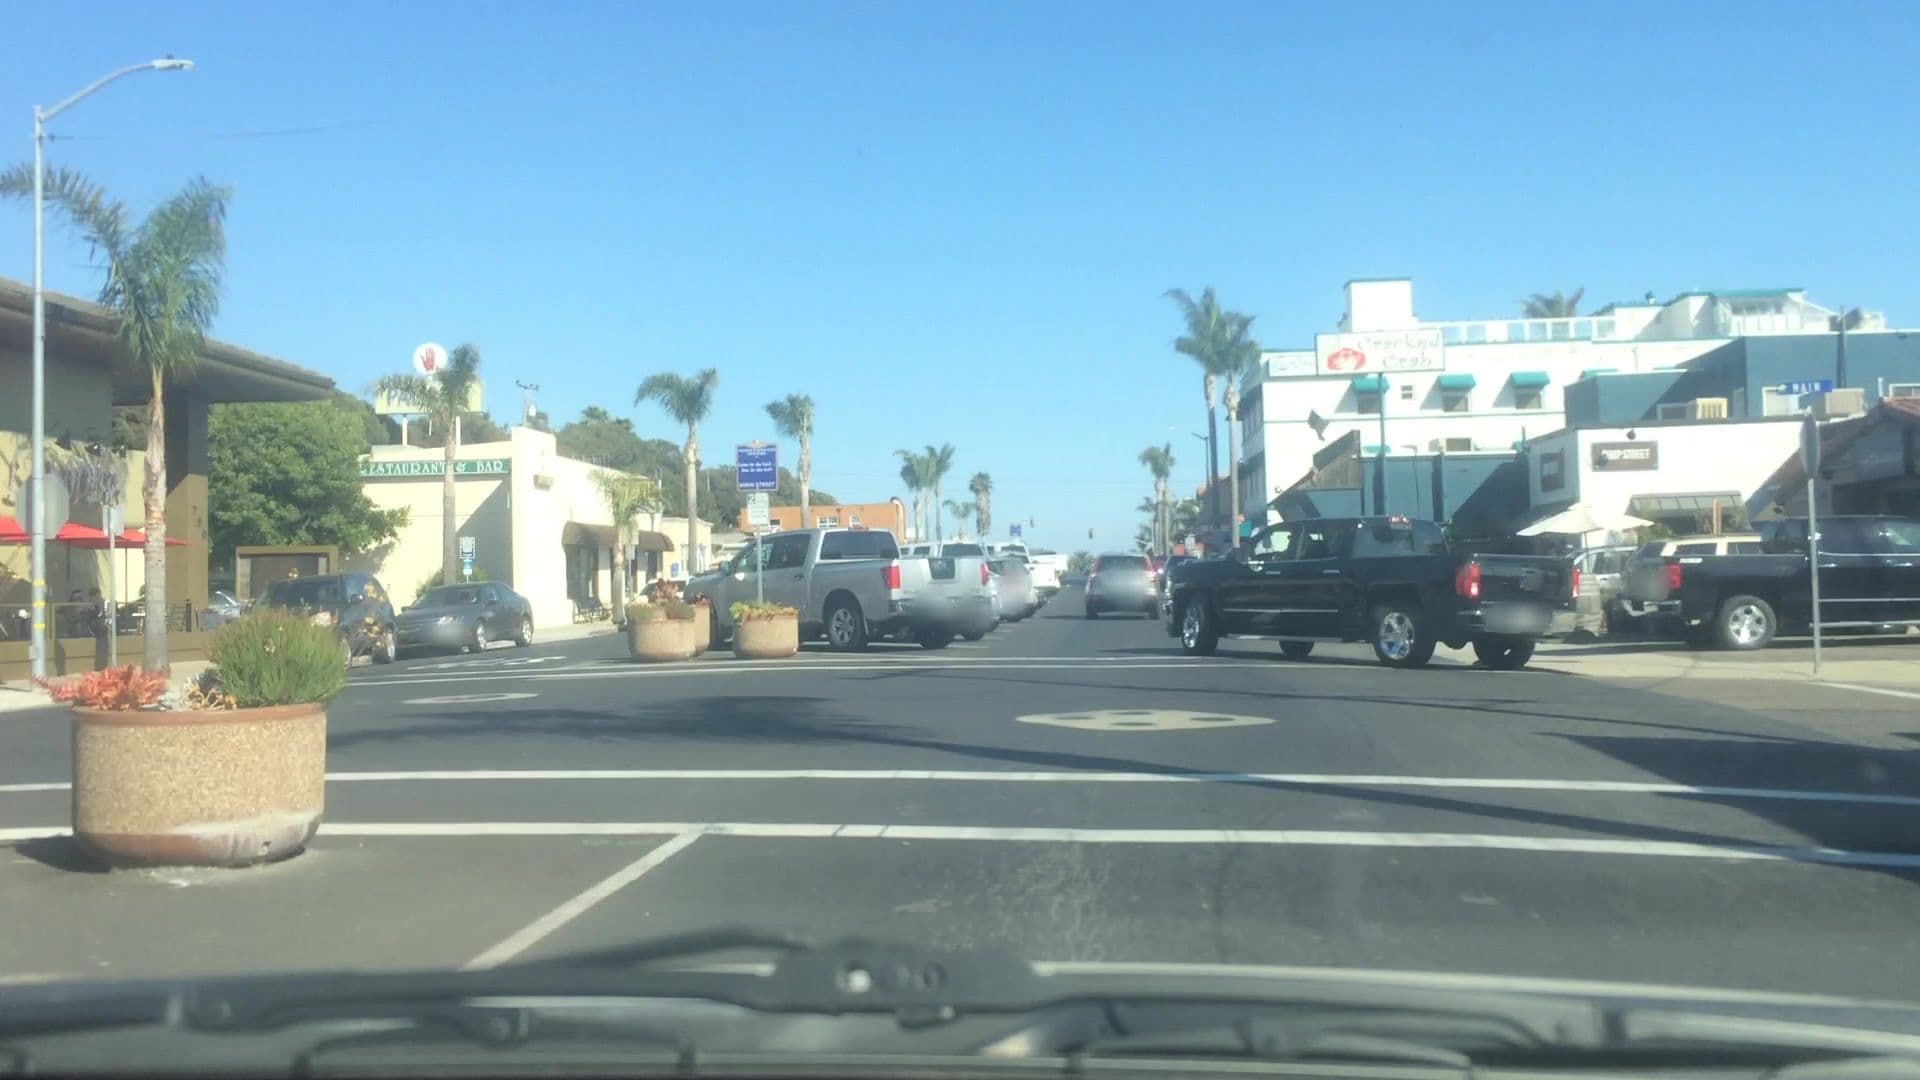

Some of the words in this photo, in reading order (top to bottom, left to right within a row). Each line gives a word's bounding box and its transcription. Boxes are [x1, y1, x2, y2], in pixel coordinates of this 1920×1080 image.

[1791, 382, 1821, 393] MAIN
[455, 462, 466, 473] &
[476, 460, 503, 473] BAR
